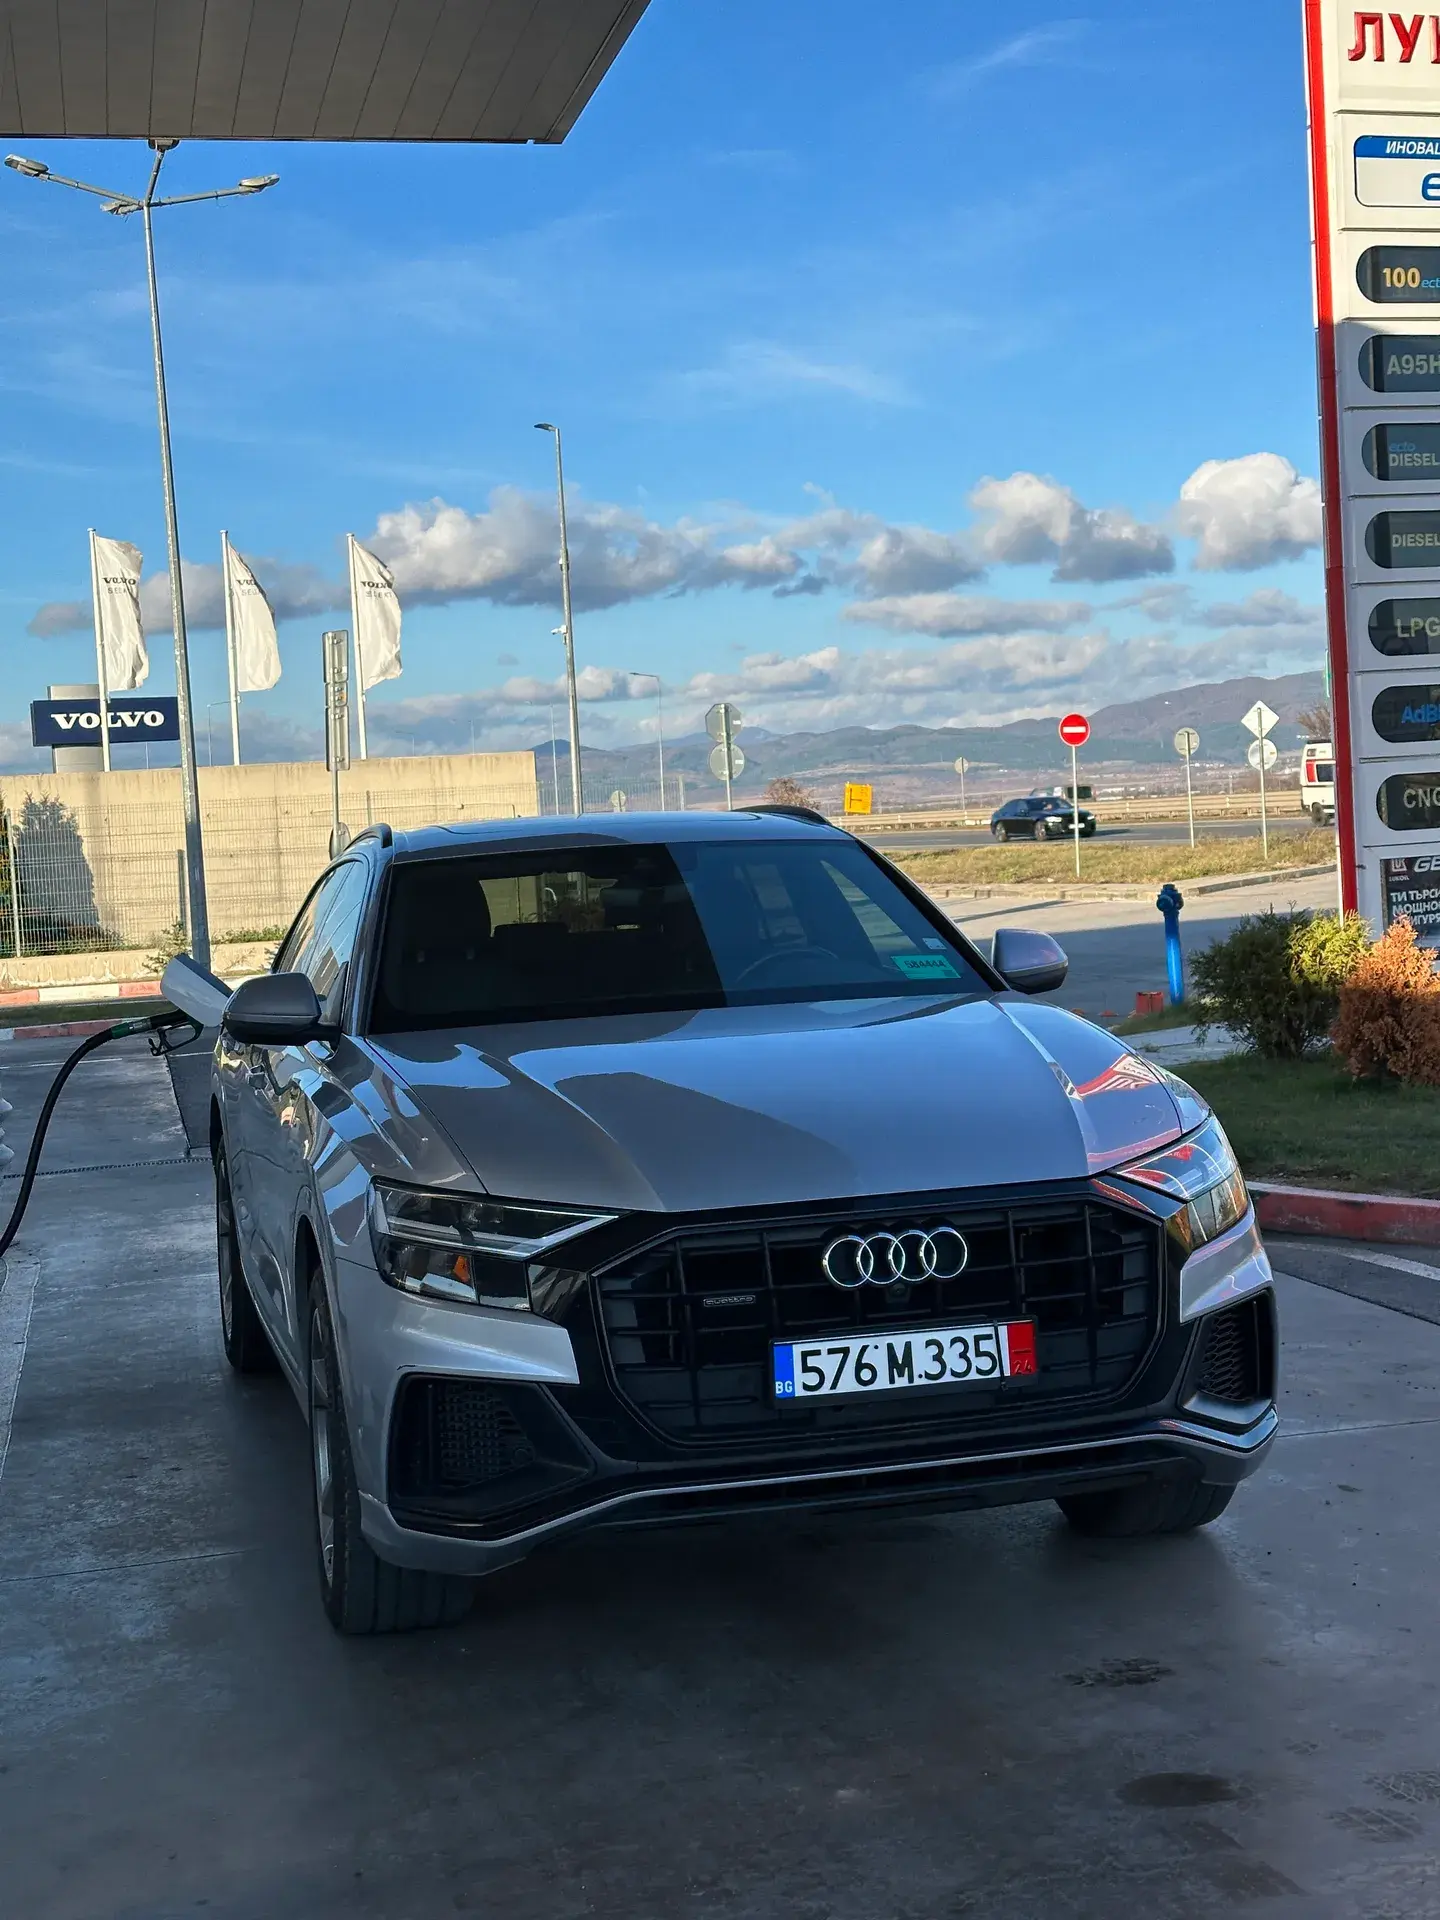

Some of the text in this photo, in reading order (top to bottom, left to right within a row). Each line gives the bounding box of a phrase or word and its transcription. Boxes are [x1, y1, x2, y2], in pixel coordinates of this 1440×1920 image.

[1382, 267, 1420, 288] 100
[1389, 453, 1440, 466] DIESEL
[1392, 534, 1440, 547] DIESEL
[1397, 617, 1440, 638] LPG
[51, 711, 164, 729] VOLVO
[1392, 900, 1440, 915] МОЩНО
[775, 1380, 793, 1394] BG
